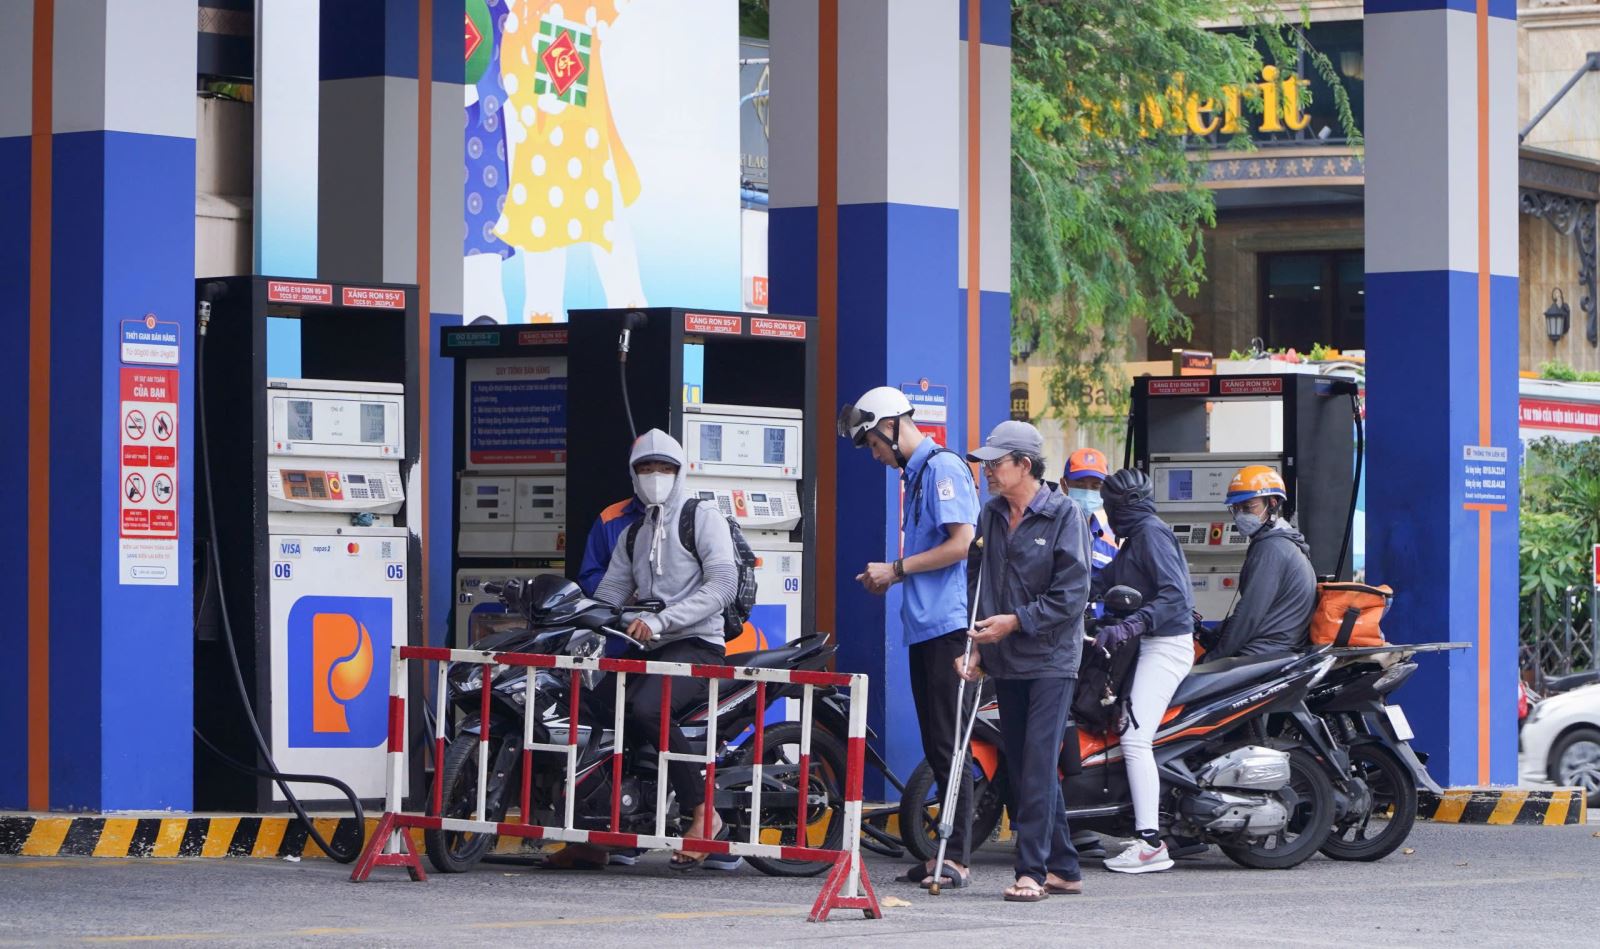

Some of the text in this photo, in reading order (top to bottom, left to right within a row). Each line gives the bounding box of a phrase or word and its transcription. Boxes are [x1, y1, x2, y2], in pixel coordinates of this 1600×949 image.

[348, 289, 400, 300] XĂNG RON 95-V
[689, 316, 707, 325] XĂNG
[755, 320, 773, 328] XĂNG
[1225, 380, 1244, 388] XĂNG
[133, 383, 166, 400] CỦA BẠN
[281, 543, 301, 555] VISA
[313, 545, 328, 553] napas
[275, 564, 291, 578] 06
[388, 565, 403, 579] 05
[785, 578, 798, 591] 09
